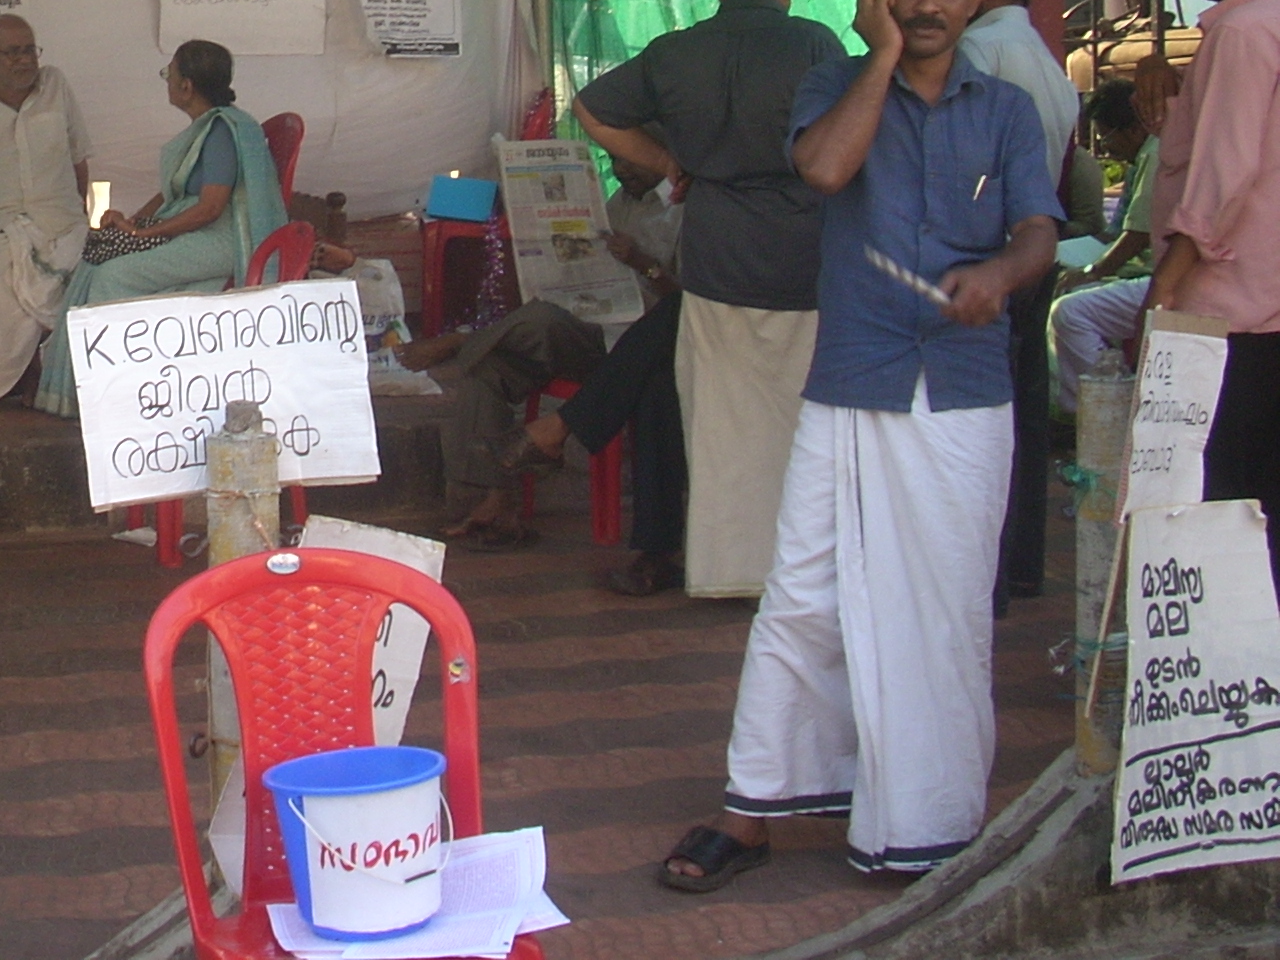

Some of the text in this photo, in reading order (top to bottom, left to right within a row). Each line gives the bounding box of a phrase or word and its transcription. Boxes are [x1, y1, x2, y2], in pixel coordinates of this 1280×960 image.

[138, 359, 272, 420] ജീവൻ
[1140, 556, 1204, 604] മാലിന്യ
[1146, 600, 1190, 639] മല
[1145, 646, 1201, 689] ഉടൻ
